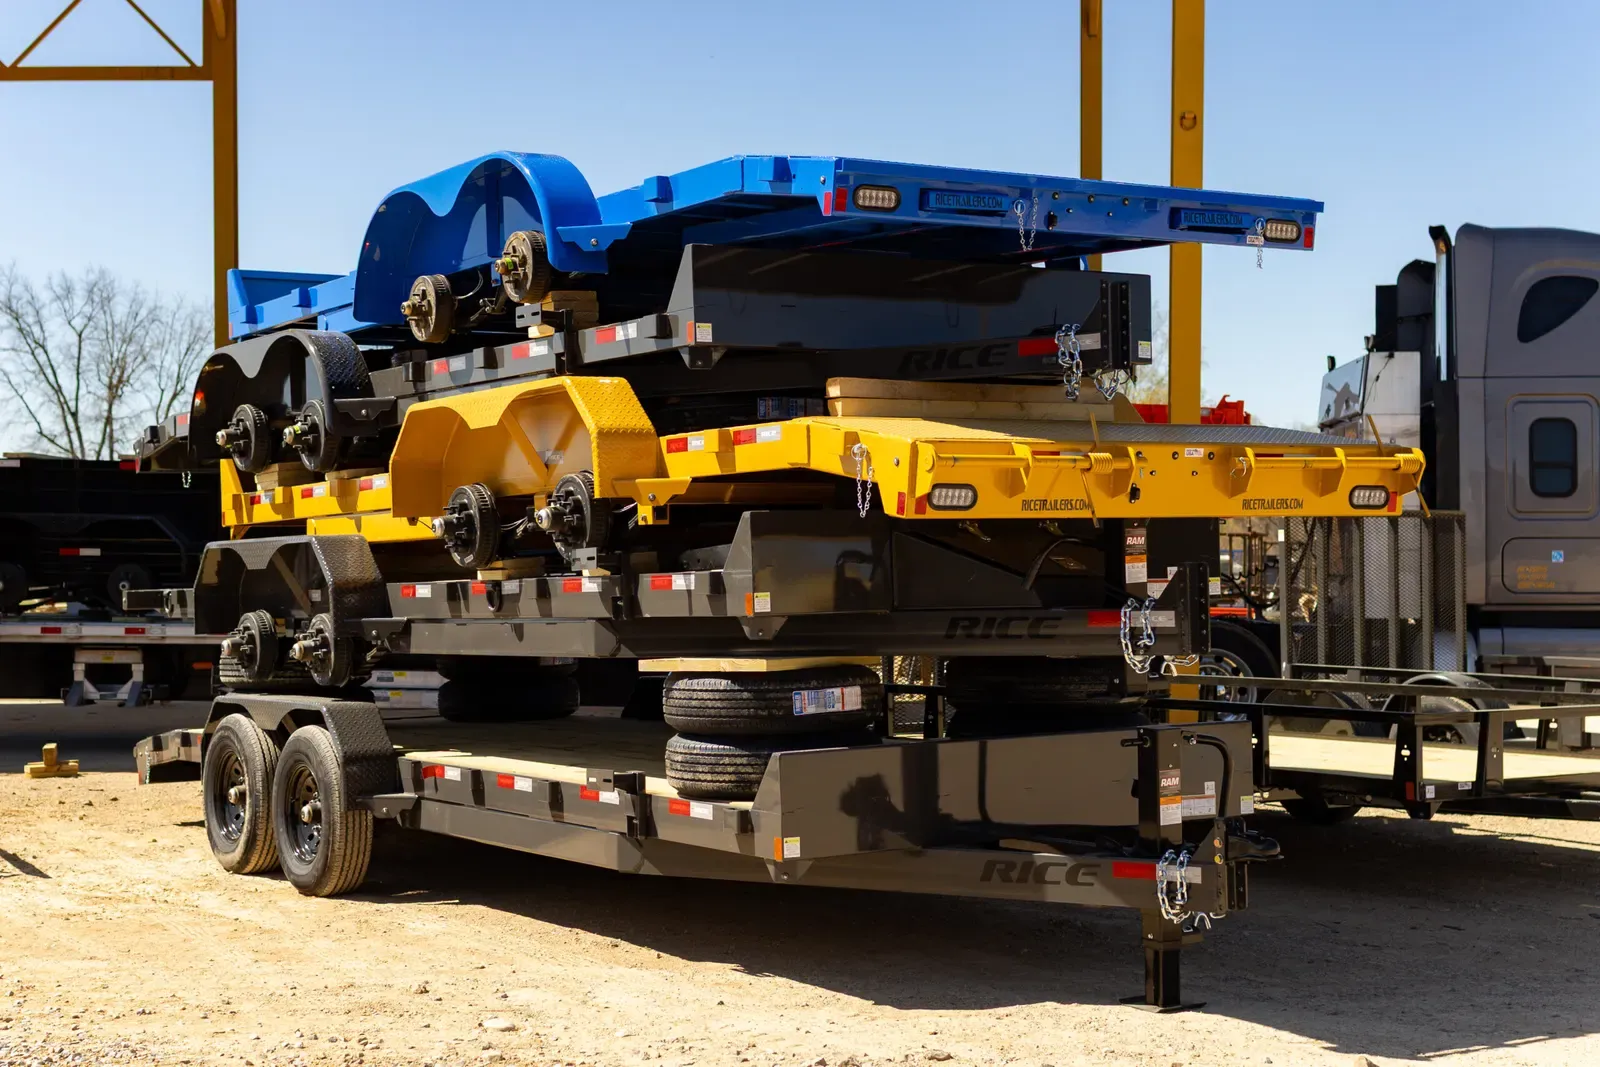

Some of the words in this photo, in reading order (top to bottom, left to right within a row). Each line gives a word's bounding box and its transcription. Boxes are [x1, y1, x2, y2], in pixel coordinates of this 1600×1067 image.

[935, 193, 1004, 210] RICETRAILERS.COM
[1183, 210, 1244, 226] RICETRAILERS.COM
[901, 344, 1011, 374] RICE
[1021, 498, 1093, 511] RICETRAILERS.COM
[1241, 498, 1304, 511] RICETRAILERS.COM
[1126, 536, 1145, 545] RAM
[944, 616, 1063, 640] RICE
[1160, 777, 1180, 787] RAM
[979, 859, 1101, 887] RICE
